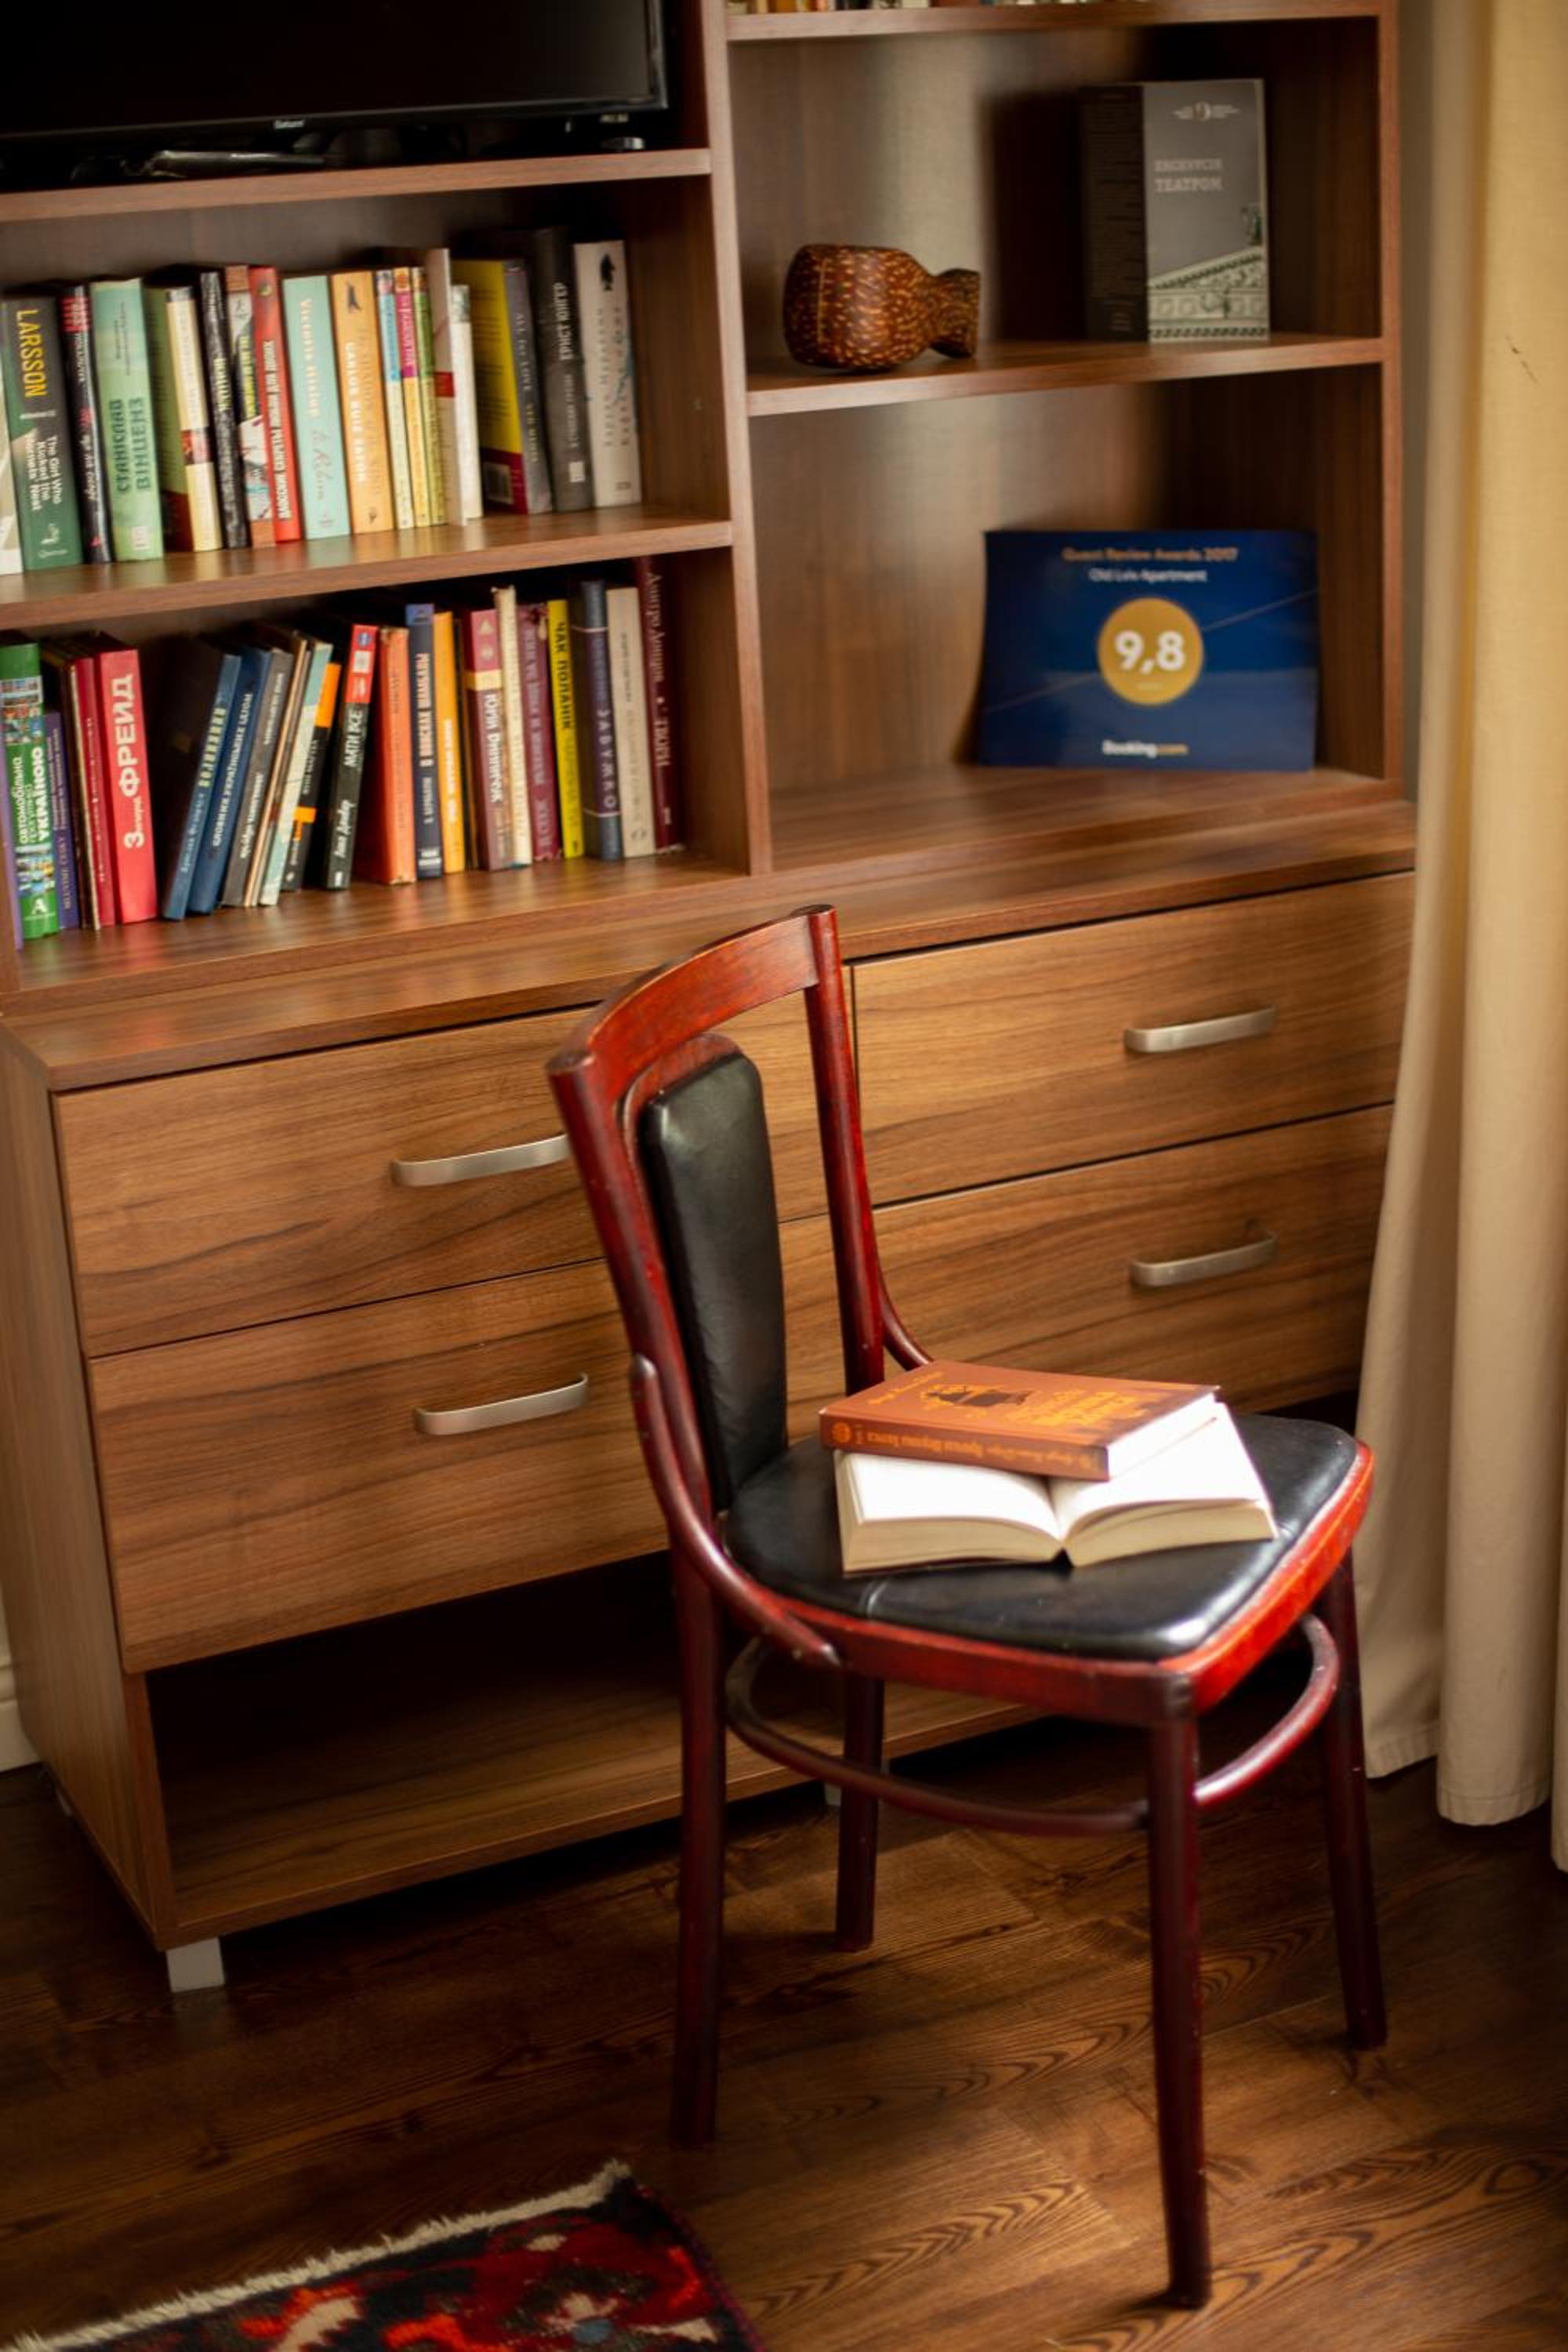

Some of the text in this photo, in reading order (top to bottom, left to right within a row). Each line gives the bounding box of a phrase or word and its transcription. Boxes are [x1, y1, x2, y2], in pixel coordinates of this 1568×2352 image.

[16, 309, 48, 398] LARSSON
[37, 441, 51, 501] Kicked the
[46, 436, 63, 504] The Girl Who
[109, 398, 131, 492] СТАНІСЛАВ
[129, 397, 151, 490] ВІНЦЕНЗ
[29, 484, 42, 511] Nest
[1088, 568, 1112, 582] Old
[1141, 569, 1207, 584] Apartment
[1153, 549, 1203, 561] Awards
[555, 622, 567, 653] ЧАК
[1114, 630, 1186, 675] 9,8
[557, 660, 572, 729] ПОЛАНІК
[343, 710, 363, 767] МАТИ ВСЕ
[597, 709, 618, 808] ЗАБУЖКО
[1102, 739, 1189, 758] Booking.com
[13, 757, 29, 844] автомобільна
[31, 746, 51, 841] УКРАЇНОЮ
